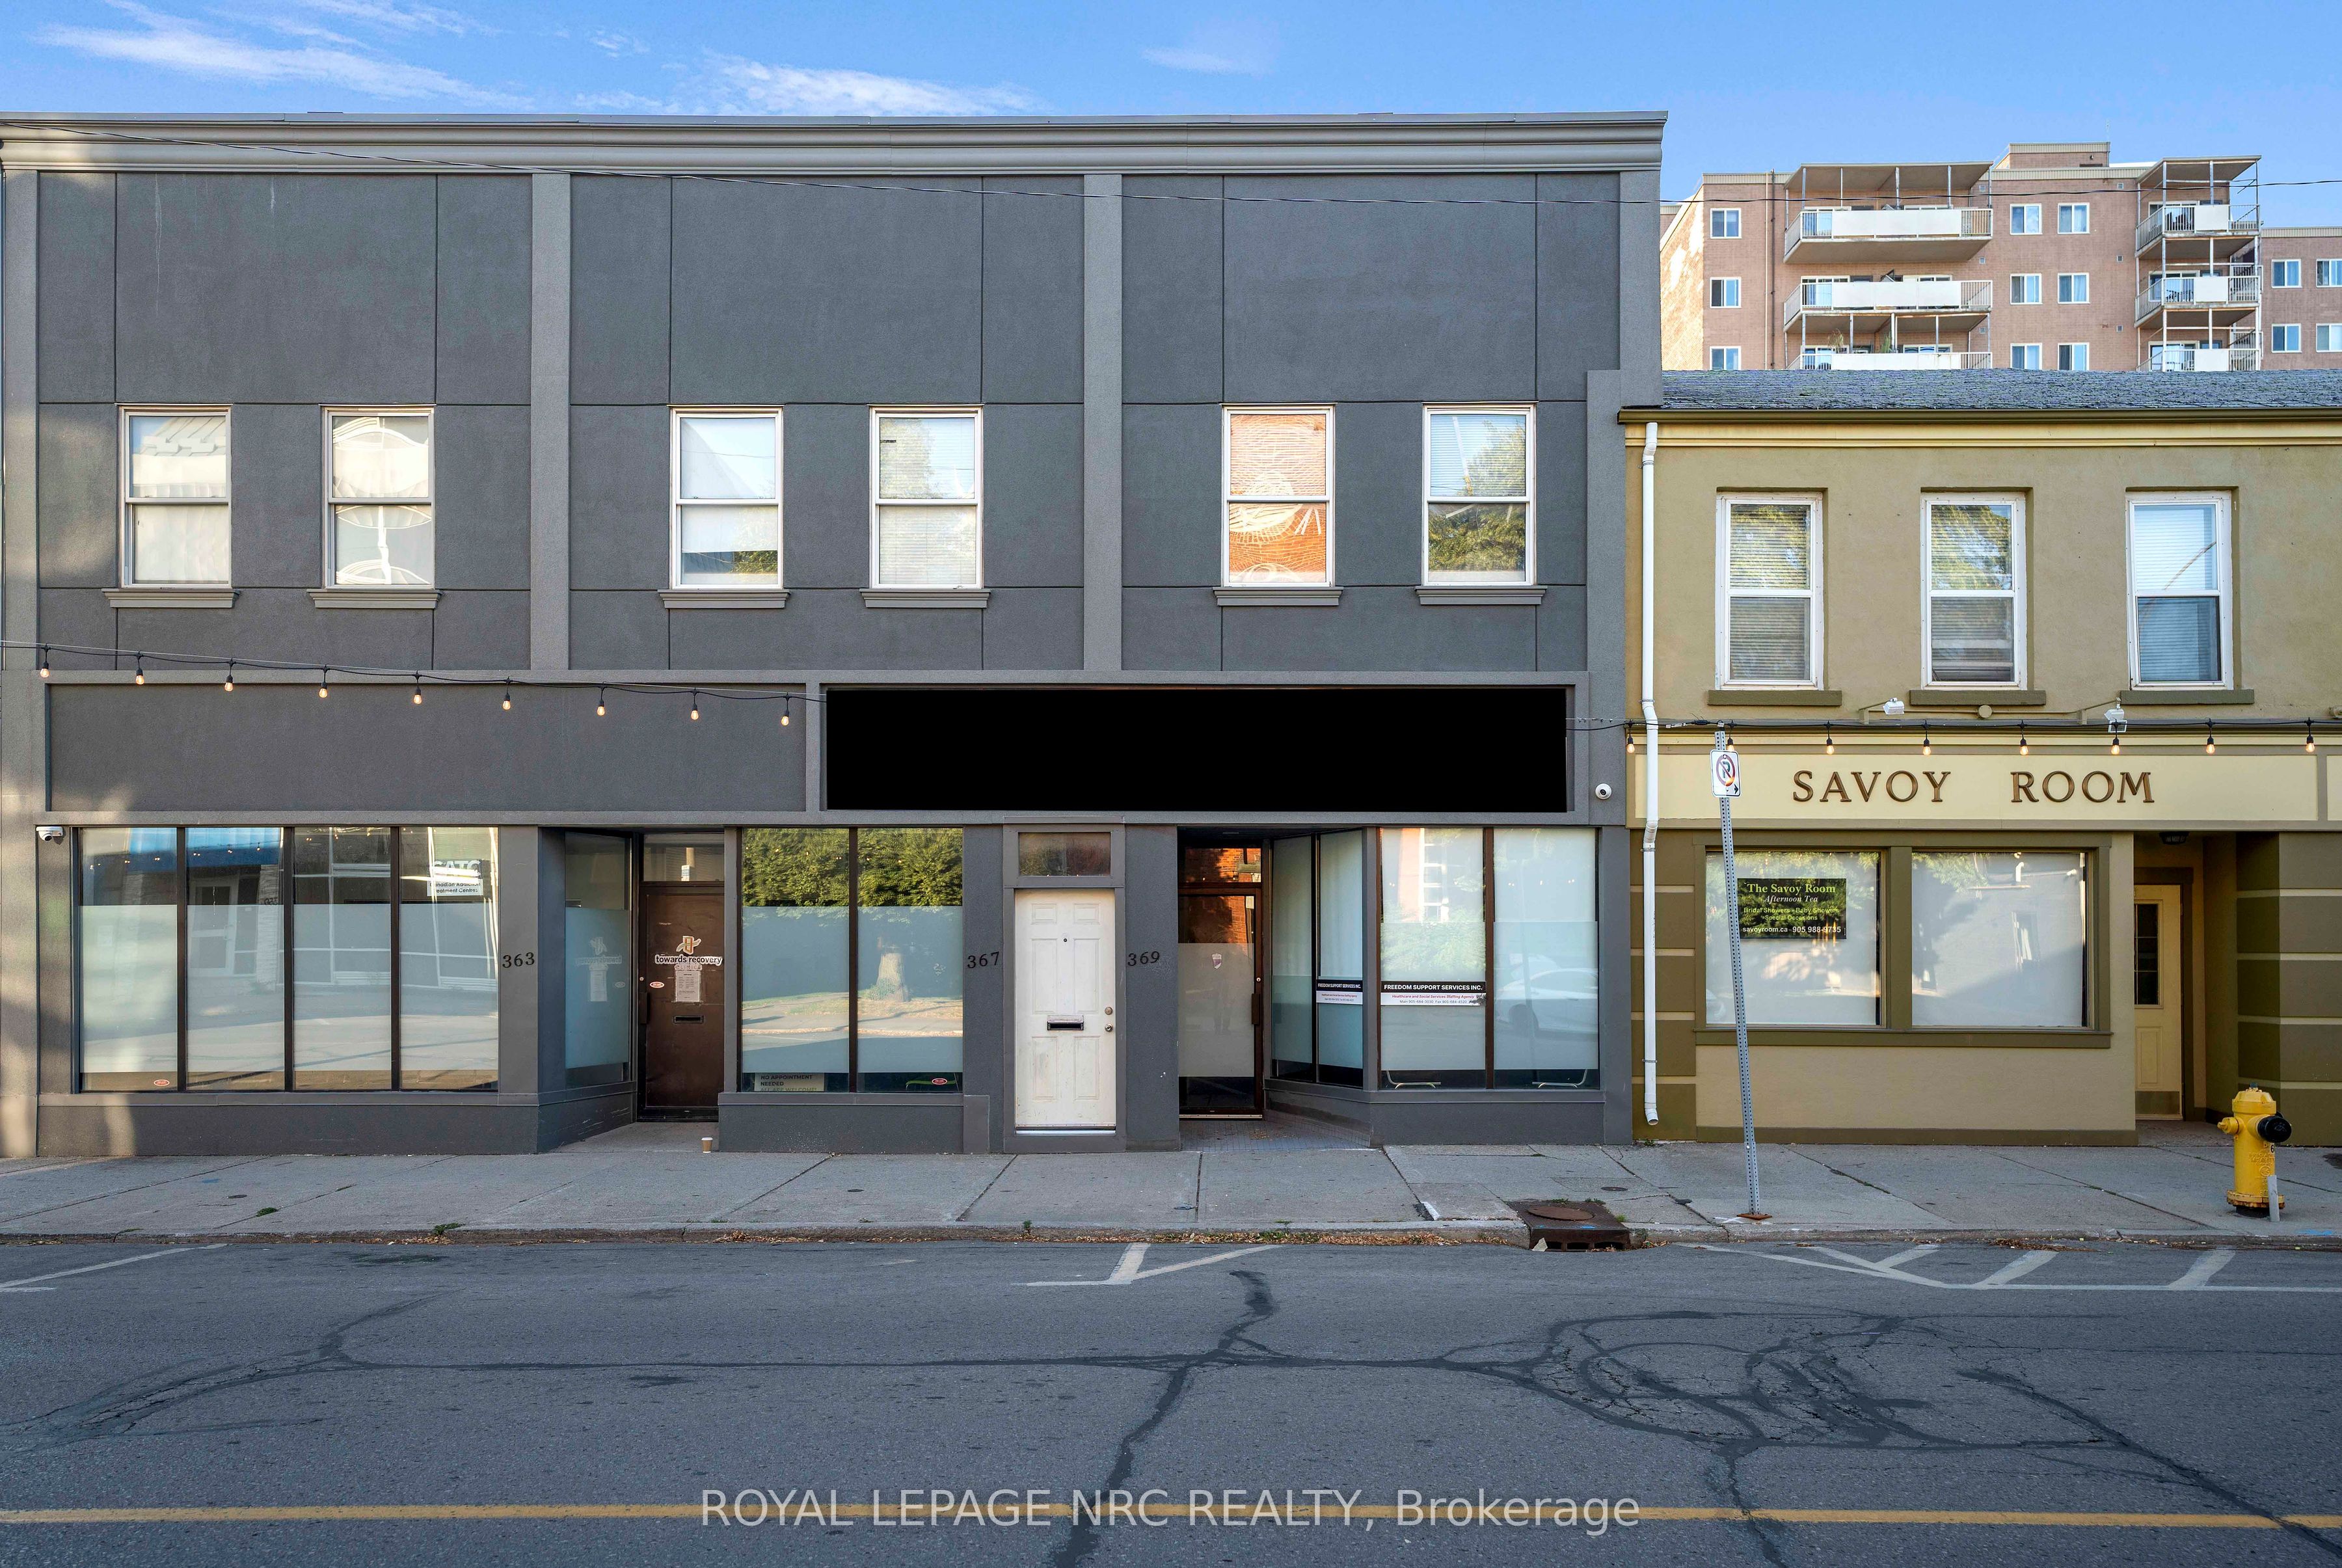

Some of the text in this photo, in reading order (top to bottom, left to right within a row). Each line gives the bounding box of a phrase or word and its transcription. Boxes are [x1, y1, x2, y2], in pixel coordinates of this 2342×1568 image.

[1793, 770, 2155, 803] SAVOY ROOM
[1747, 884, 1836, 895] The Savoy Room
[1764, 895, 1801, 904] Afternoon
[1742, 926, 1788, 935] savoyroom.ca
[502, 952, 535, 968] 363
[967, 951, 999, 968] 367
[1127, 951, 1160, 966] 369
